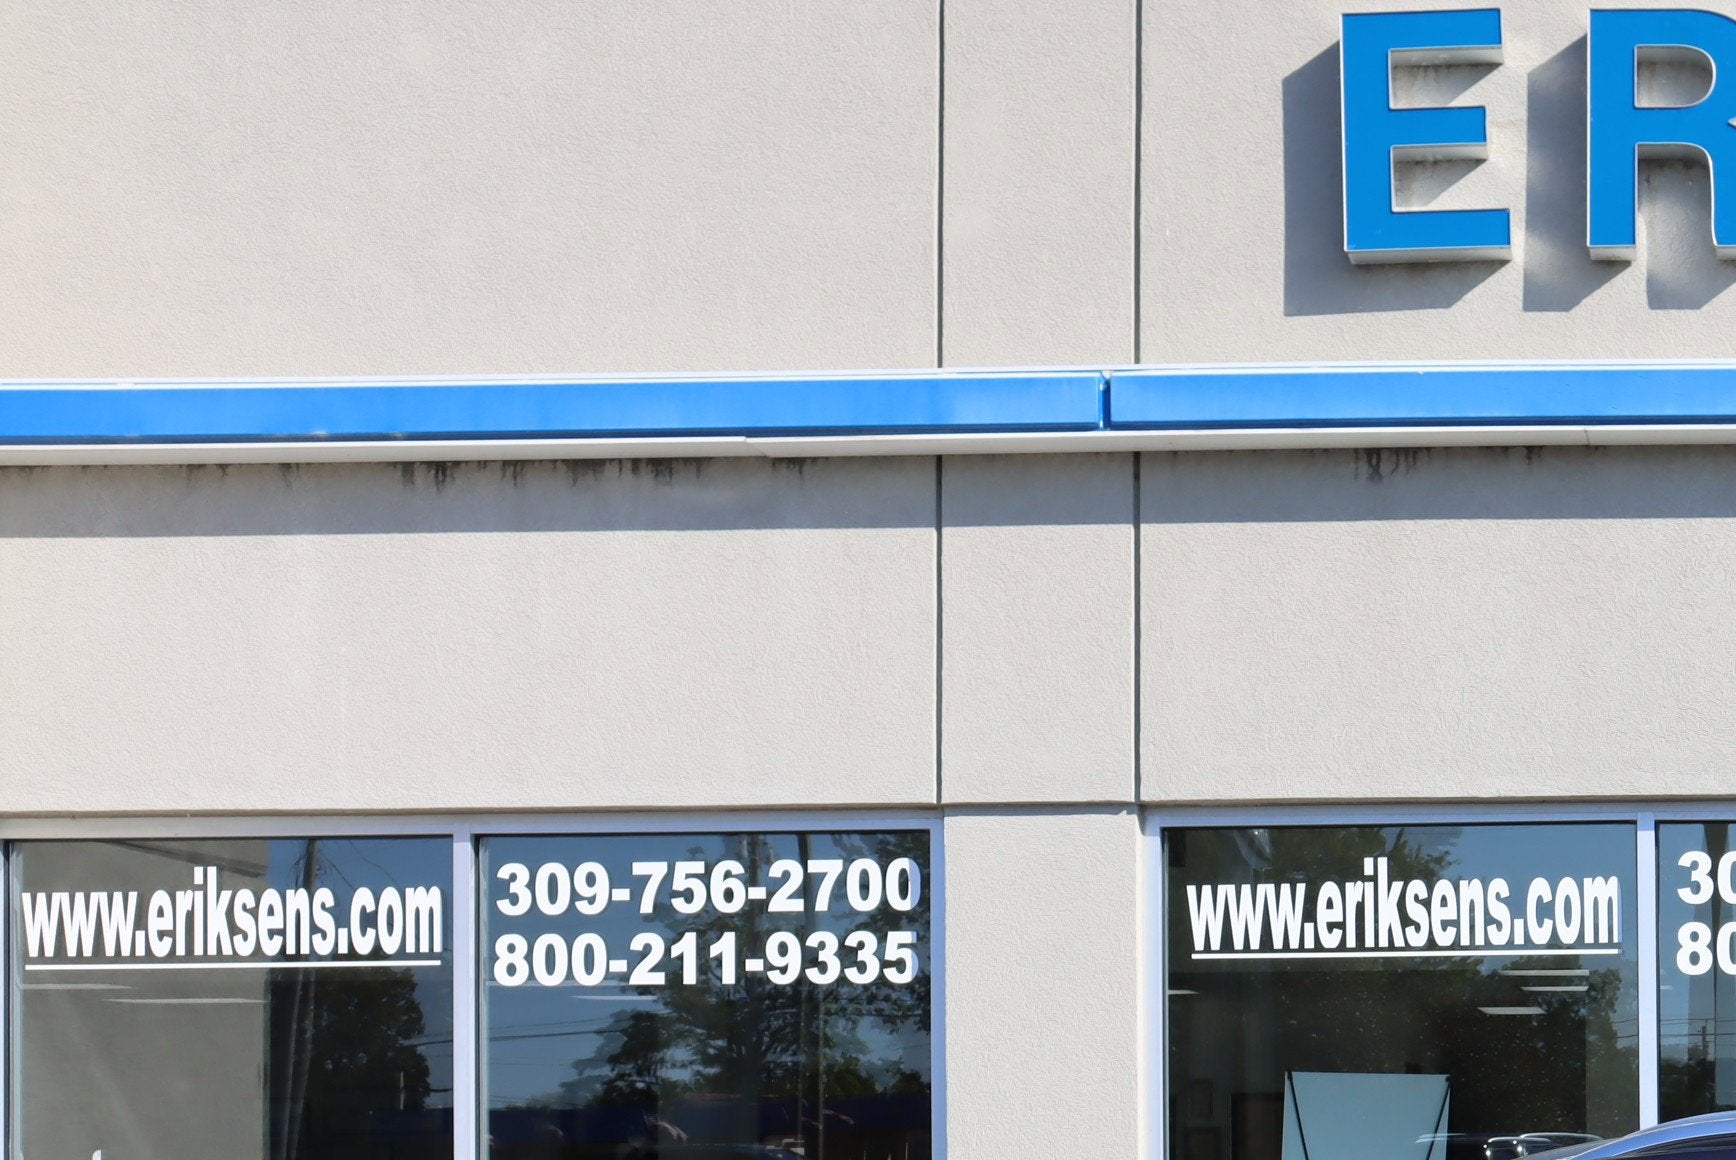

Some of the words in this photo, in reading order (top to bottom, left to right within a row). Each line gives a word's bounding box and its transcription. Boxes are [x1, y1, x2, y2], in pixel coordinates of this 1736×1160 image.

[22, 866, 443, 958] www.eriksens.com
[495, 857, 921, 917] 309-756-2700
[1186, 857, 1622, 951] www.eriksens.com
[493, 931, 918, 986] 800-211-9335
